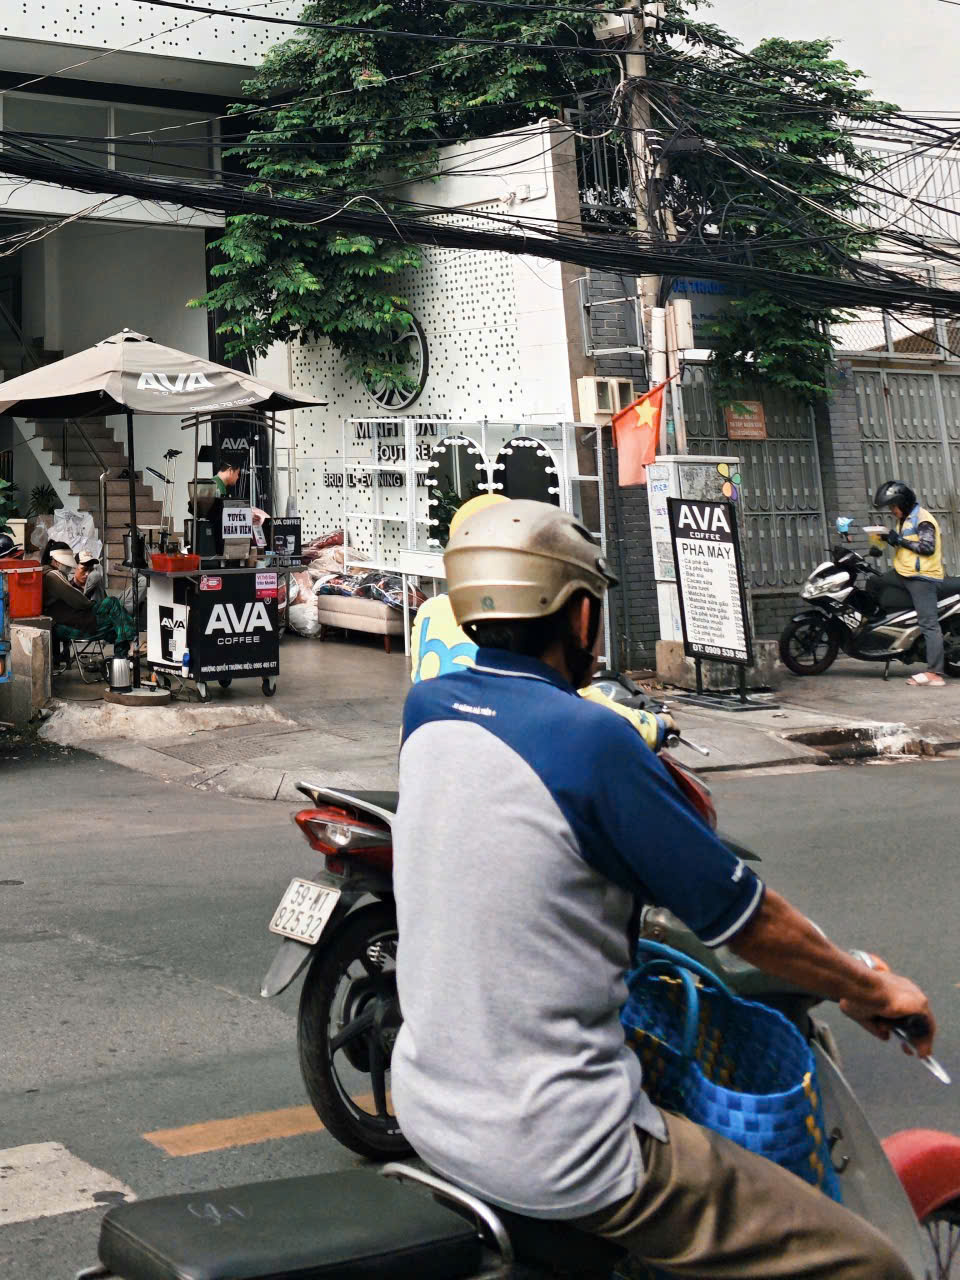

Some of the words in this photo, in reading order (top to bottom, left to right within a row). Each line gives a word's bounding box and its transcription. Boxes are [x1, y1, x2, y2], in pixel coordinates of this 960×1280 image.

[137, 371, 217, 393] AVA
[222, 438, 250, 450] AVA
[678, 504, 731, 533] AVA
[689, 531, 721, 541] COFFEE
[681, 542, 705, 558] PHA
[160, 617, 186, 630] AVA
[204, 602, 274, 636] AVA
[217, 635, 261, 646] COFFEE
